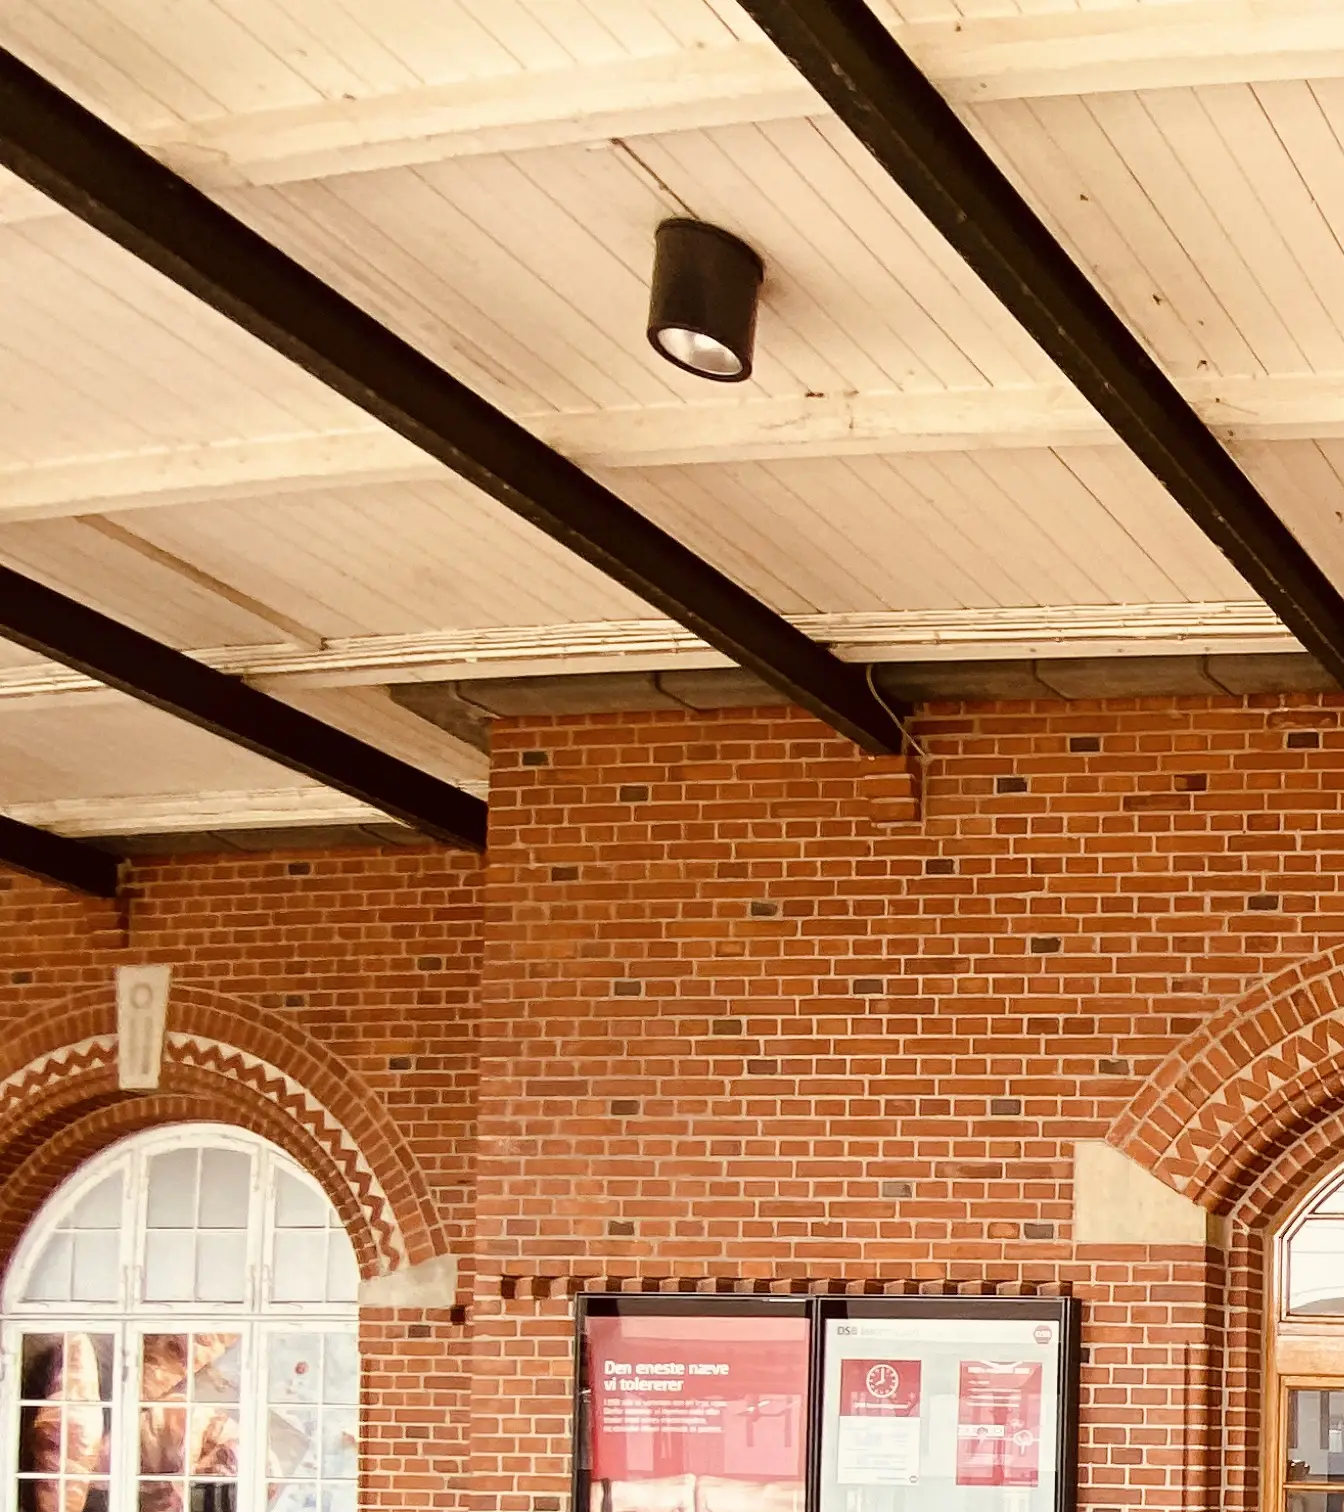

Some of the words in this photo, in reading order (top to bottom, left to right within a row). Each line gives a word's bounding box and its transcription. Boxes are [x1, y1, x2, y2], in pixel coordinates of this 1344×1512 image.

[604, 1360, 632, 1375] Den
[636, 1363, 685, 1375] eneste
[604, 1377, 617, 1391] vi
